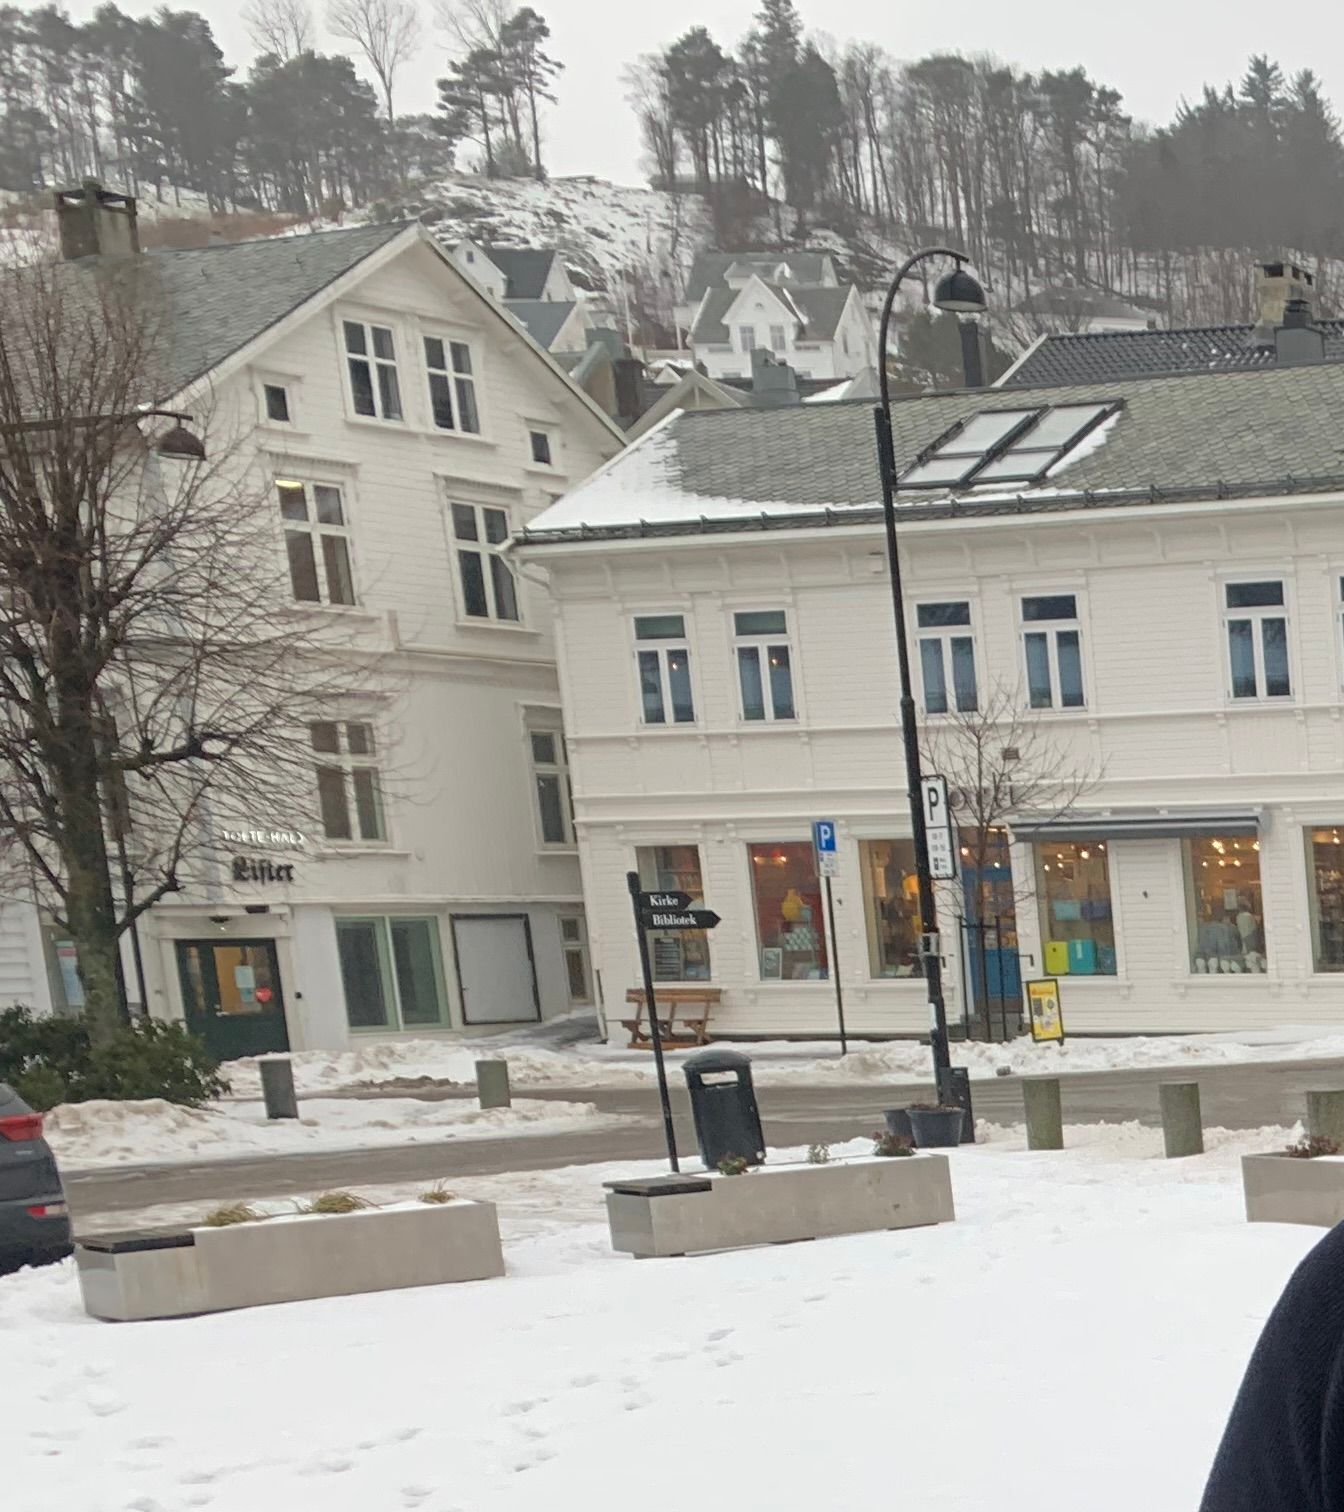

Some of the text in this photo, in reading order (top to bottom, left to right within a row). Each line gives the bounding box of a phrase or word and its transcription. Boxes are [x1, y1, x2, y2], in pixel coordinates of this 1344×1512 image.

[928, 787, 939, 821] P
[820, 825, 831, 848] P
[650, 894, 679, 906] Kirke
[652, 914, 697, 926] Bibliotek
